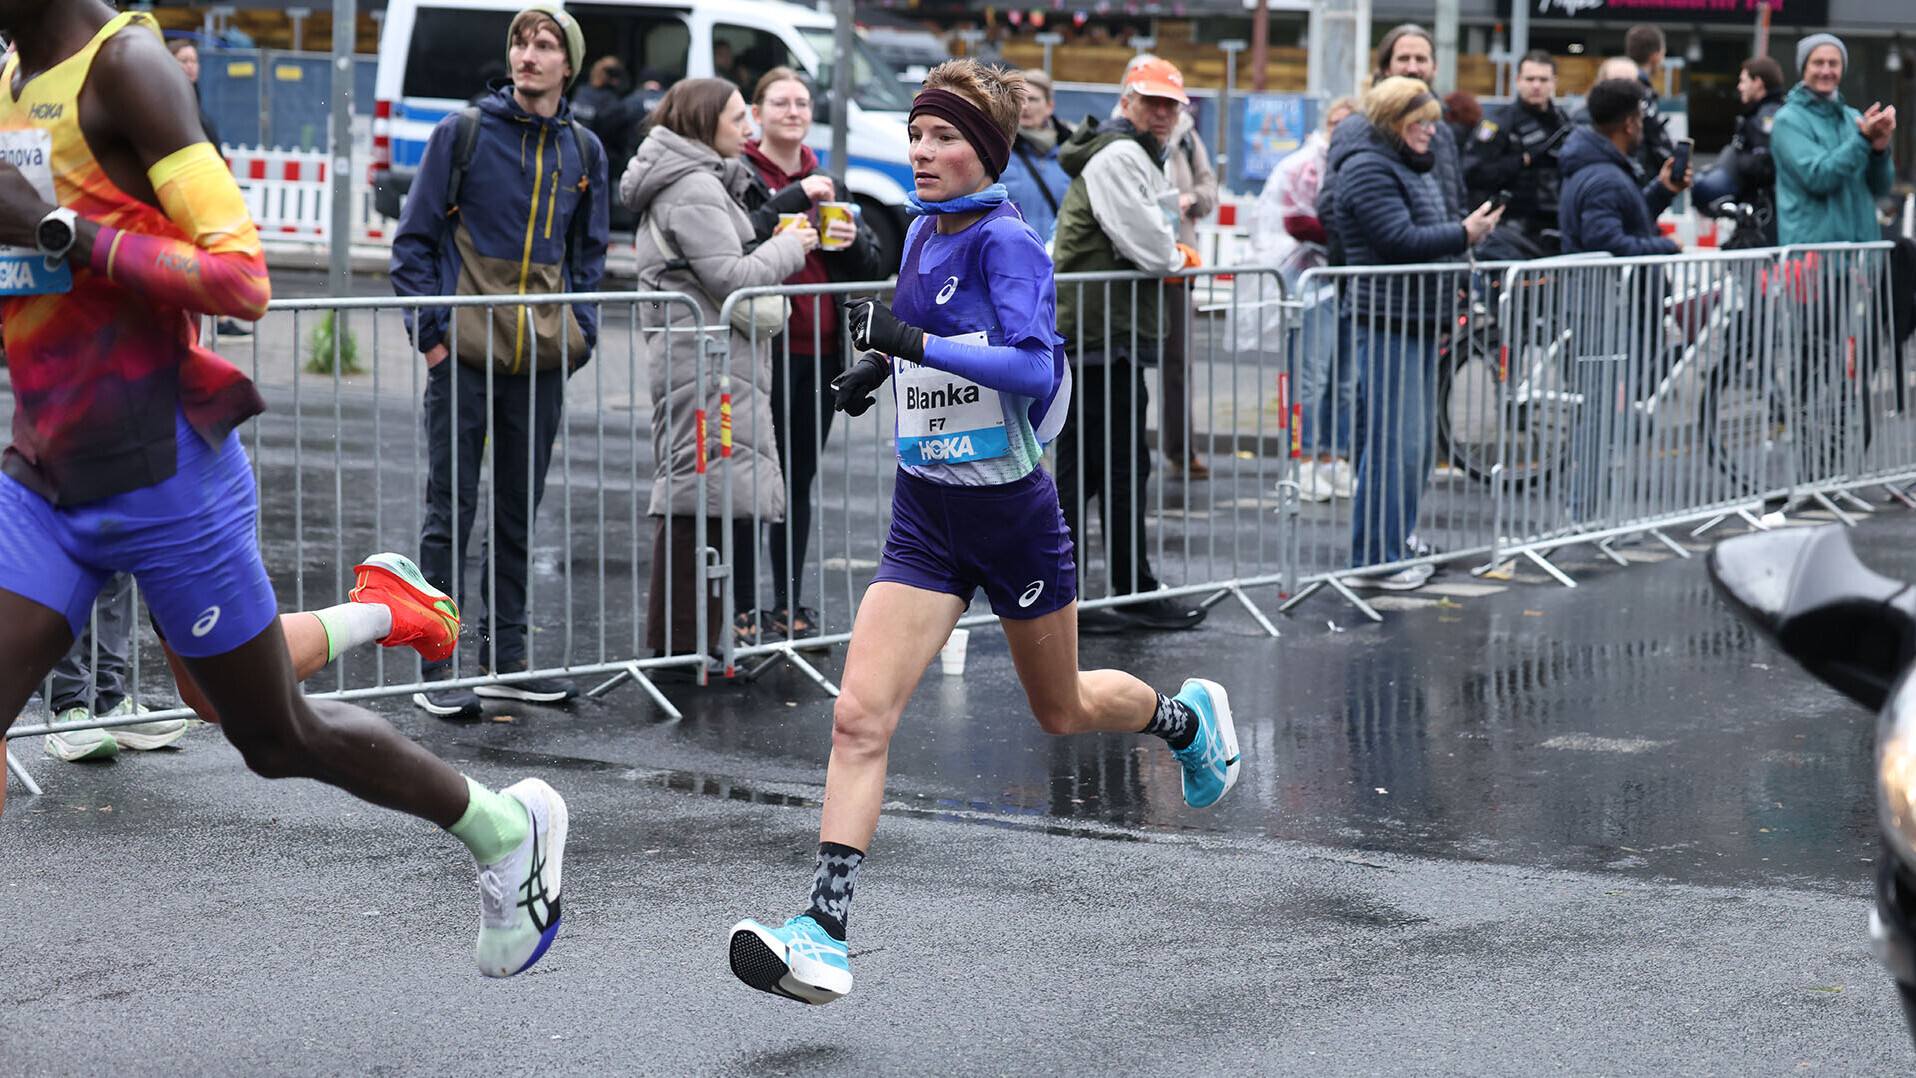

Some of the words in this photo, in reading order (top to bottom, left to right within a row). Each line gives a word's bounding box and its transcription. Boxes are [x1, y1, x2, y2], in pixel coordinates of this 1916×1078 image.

[28, 103, 63, 119] HOKA
[906, 383, 980, 410] Blanka
[929, 417, 946, 432] F7
[918, 435, 974, 460] HOKA
